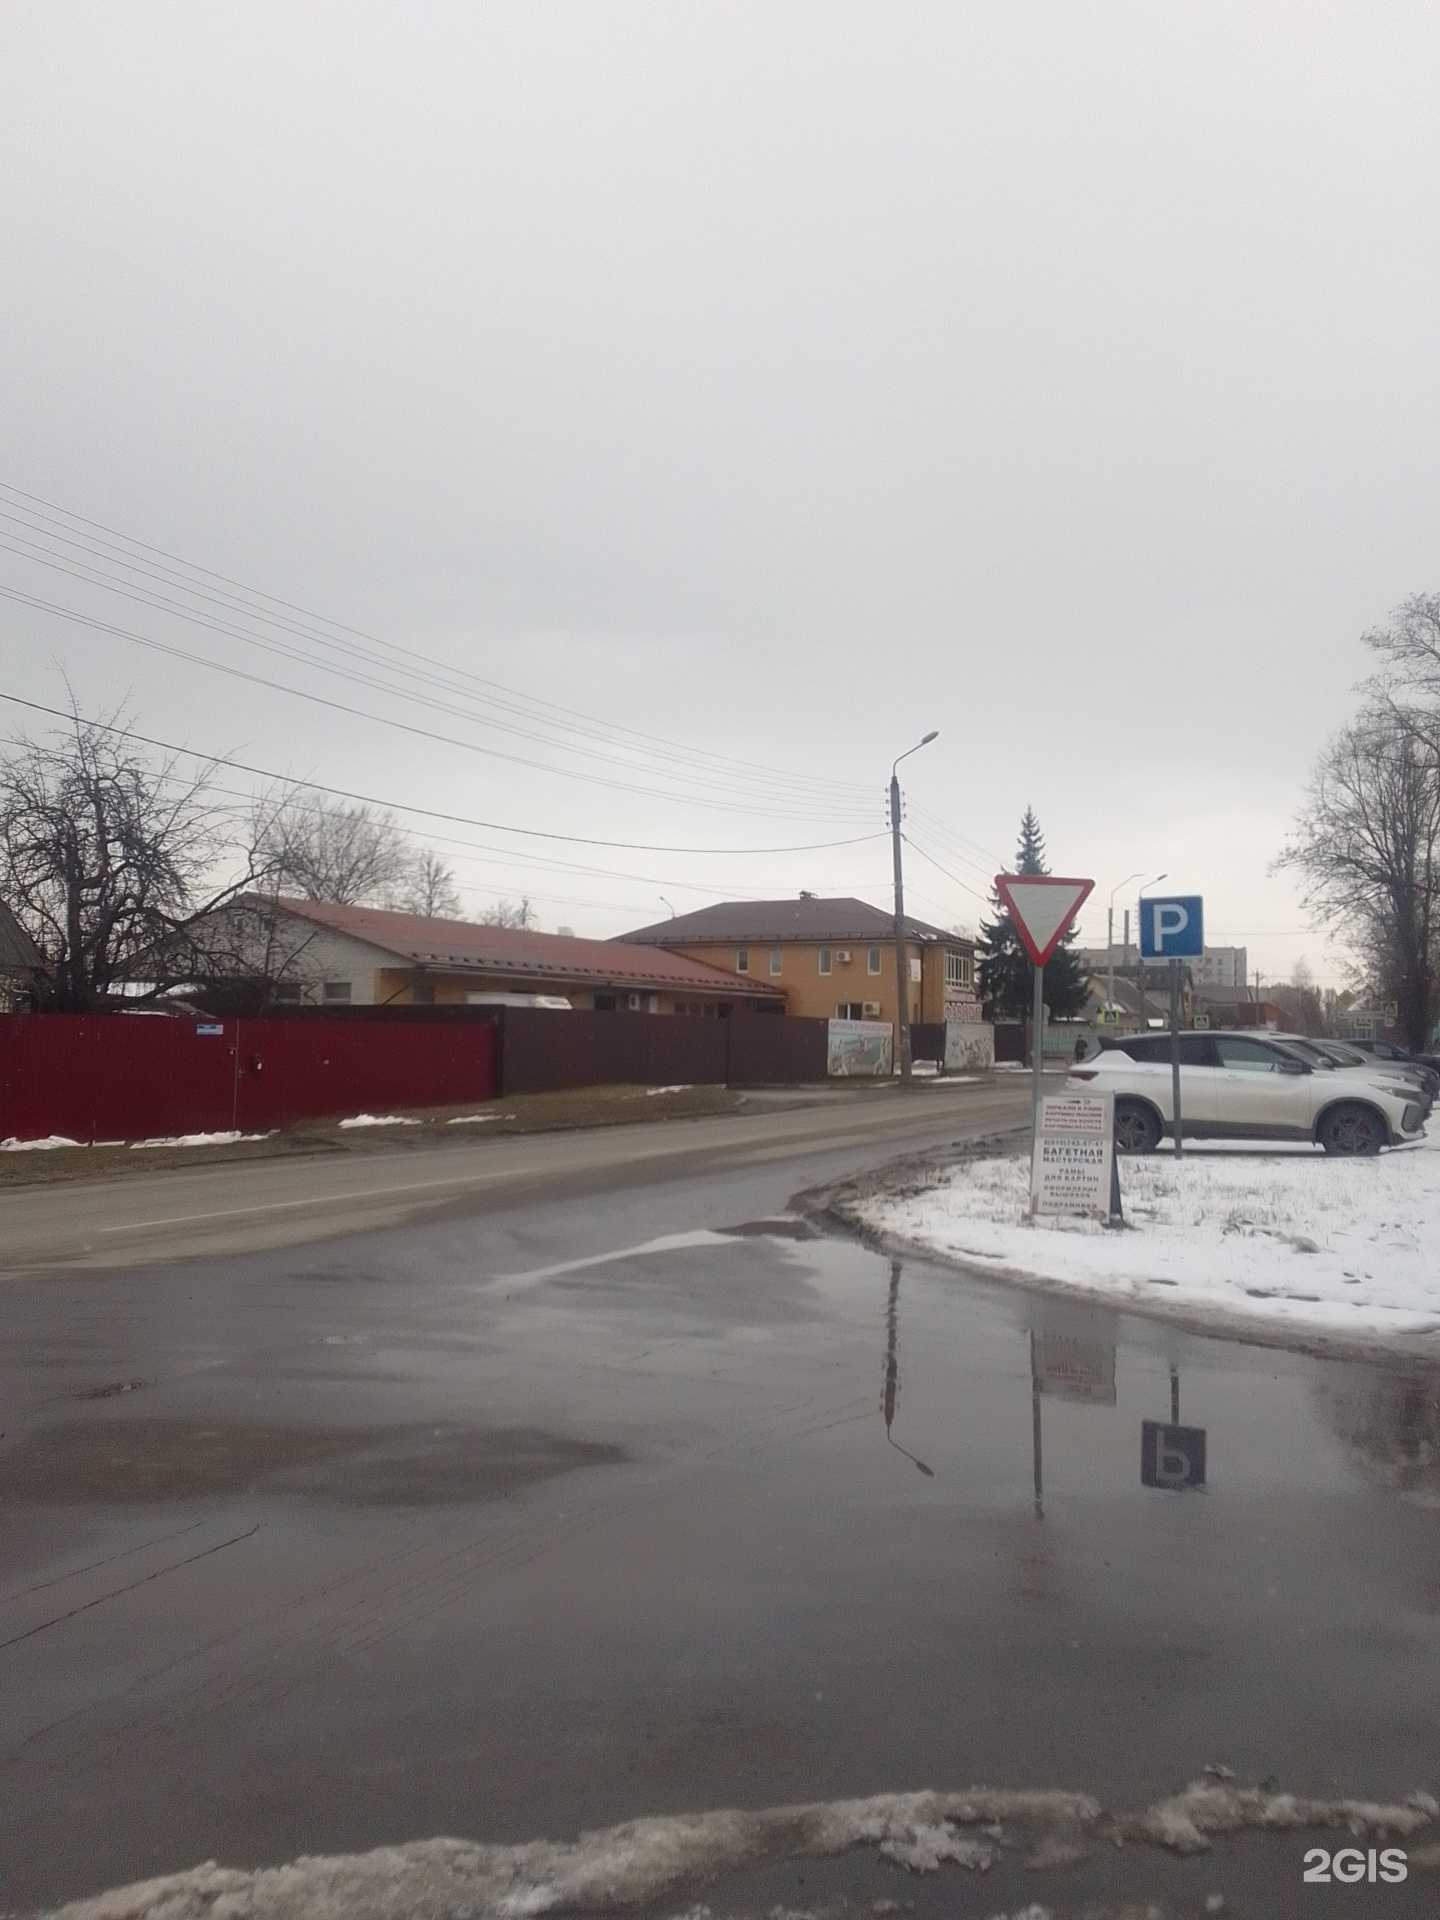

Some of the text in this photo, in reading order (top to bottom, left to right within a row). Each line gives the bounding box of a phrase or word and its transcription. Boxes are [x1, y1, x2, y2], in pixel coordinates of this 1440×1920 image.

[1153, 903, 1189, 952] P
[1043, 1147, 1103, 1157] БАГЕТНАЯ
[1043, 1156, 1103, 1165] МАСТЕРСКАЯ
[1065, 1175, 1099, 1183] КАРТИН
